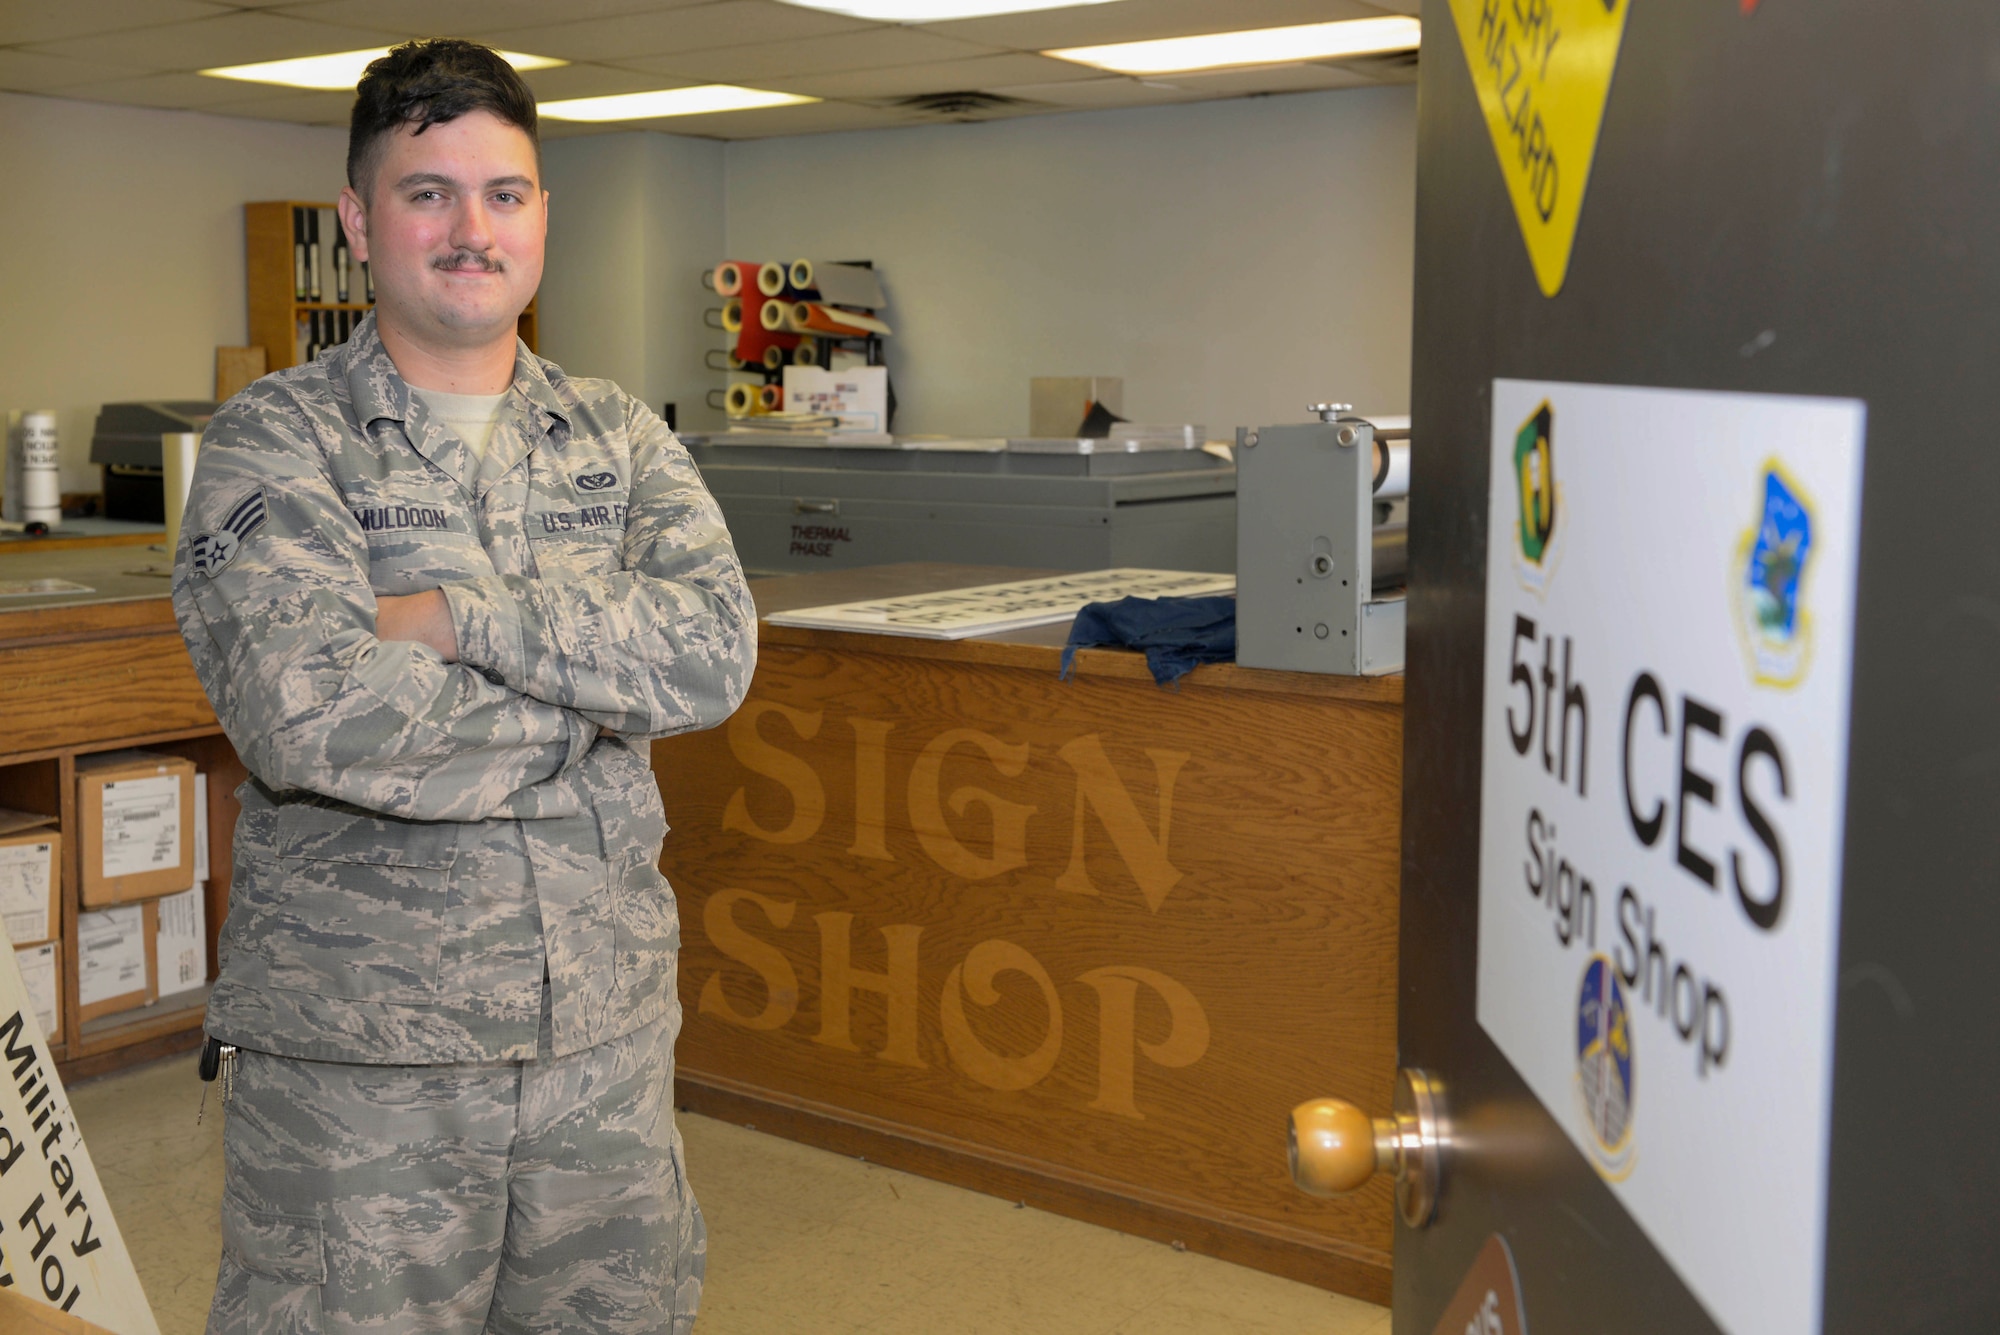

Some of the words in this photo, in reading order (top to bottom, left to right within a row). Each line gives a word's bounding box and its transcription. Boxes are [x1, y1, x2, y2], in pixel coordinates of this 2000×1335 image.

[1478, 0, 1559, 224] HAZARD
[353, 506, 447, 531] MULDOON
[541, 512, 576, 533] U.S.
[581, 505, 612, 528] AIR
[789, 541, 834, 557] PHASE
[790, 525, 852, 542] THERMAL
[722, 699, 1192, 916] SIGN
[1506, 611, 1588, 798] 5th
[1622, 668, 1792, 930] CES
[699, 887, 1211, 1120] SHOP
[1524, 807, 1597, 949] Sign
[1614, 886, 1731, 1080] Shop
[0, 1010, 102, 1258] Military
[18, 1191, 83, 1319] Hol
